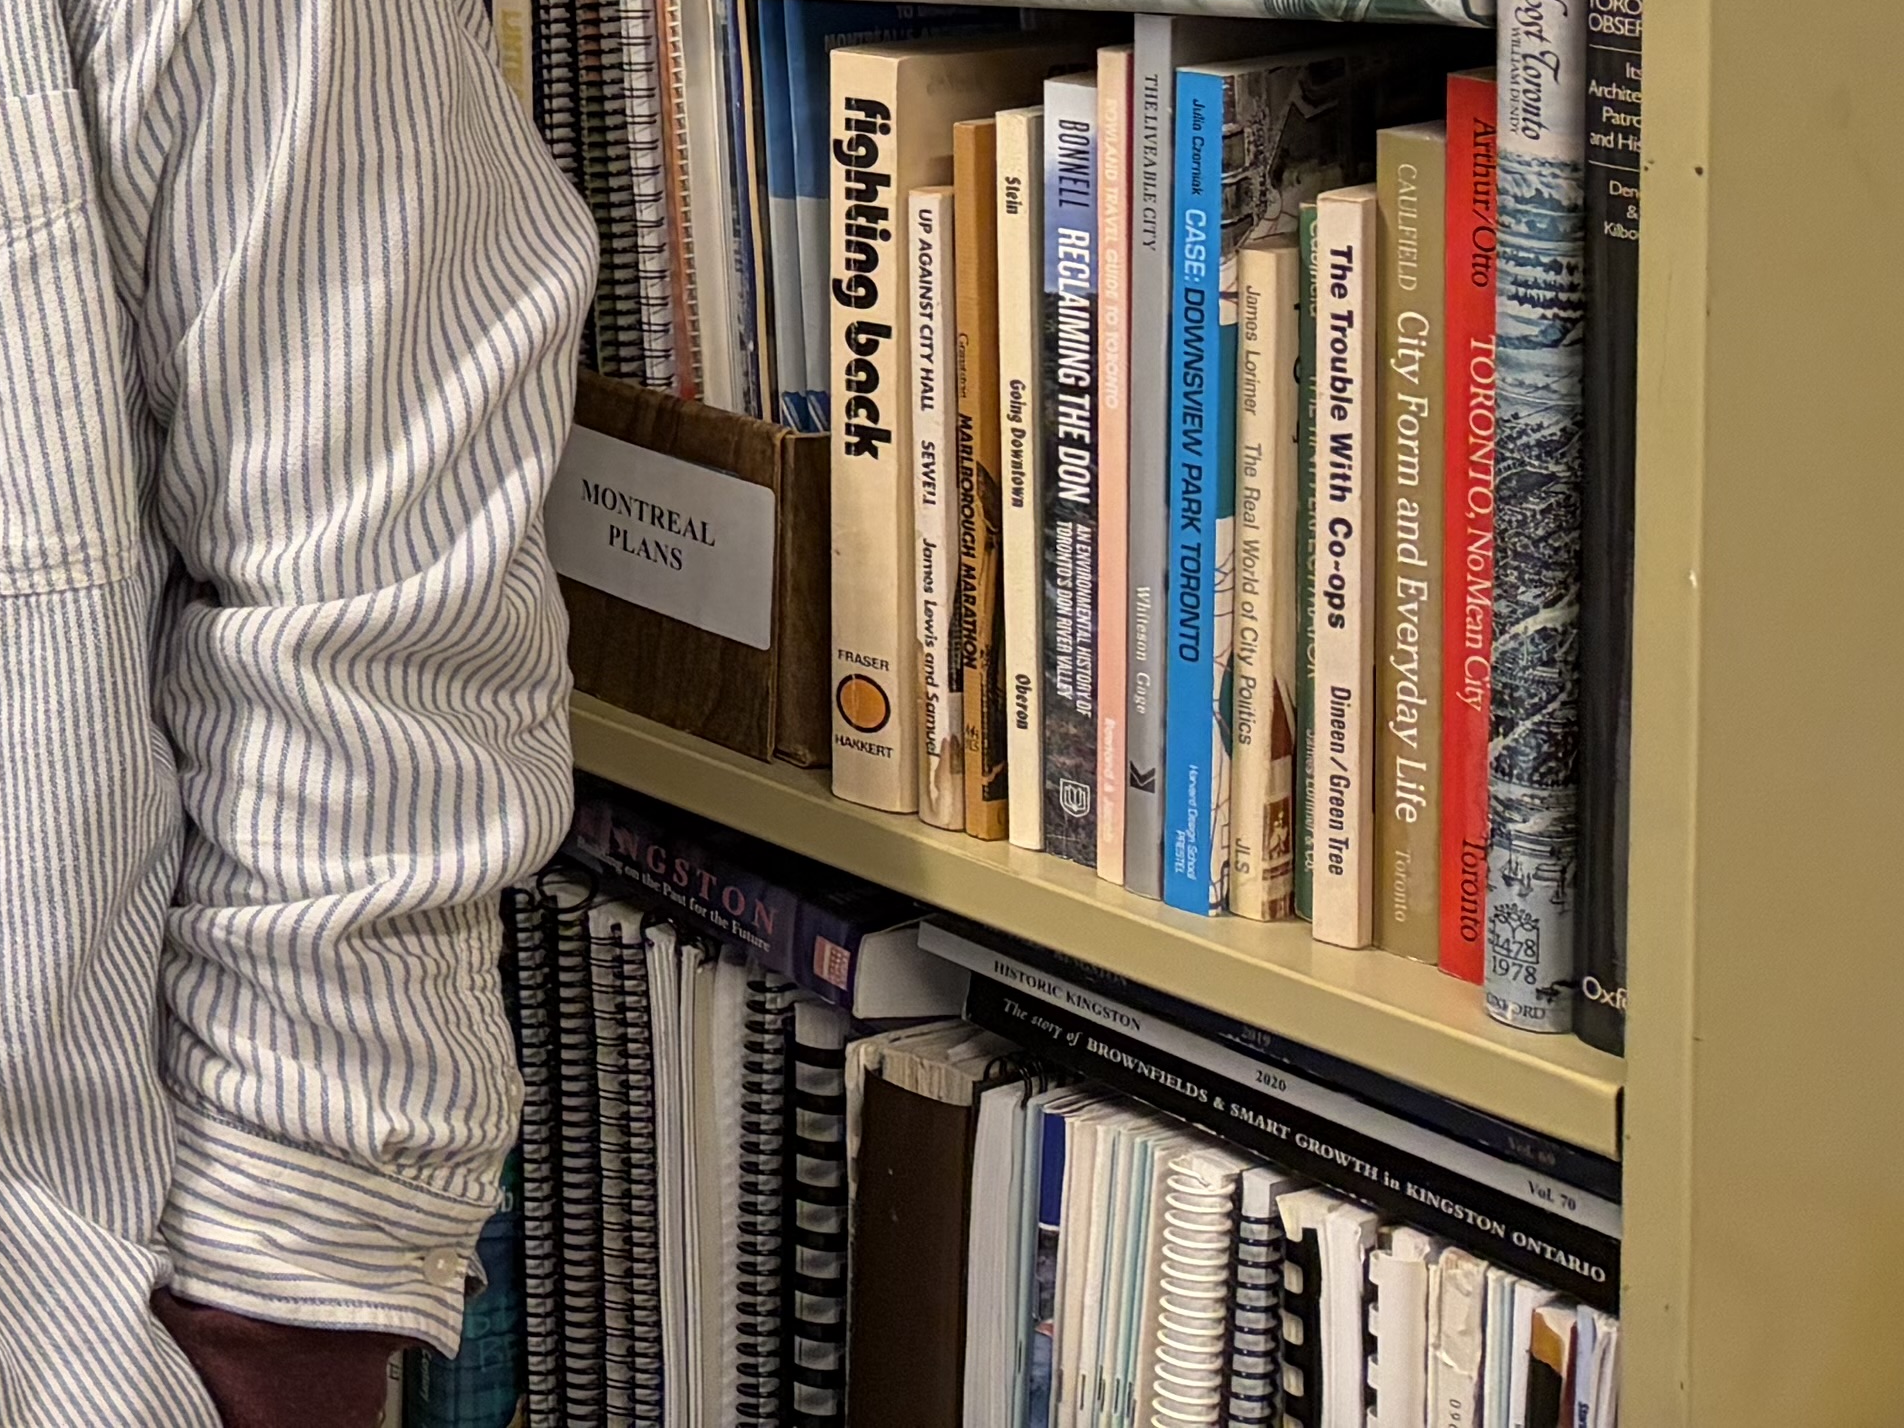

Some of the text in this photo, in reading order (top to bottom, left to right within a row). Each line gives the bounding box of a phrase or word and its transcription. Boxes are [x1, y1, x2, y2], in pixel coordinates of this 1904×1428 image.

[833, 96, 895, 462] fighting back
[1328, 244, 1354, 294] The
[1057, 226, 1090, 505] RECLAIMING THE DON
[1327, 299, 1354, 423] Trouble
[1327, 430, 1355, 505] With
[581, 476, 716, 548] MONTREAL
[607, 518, 685, 575] PLANS
[992, 959, 1142, 1032] HISTORIC KINGSTON
